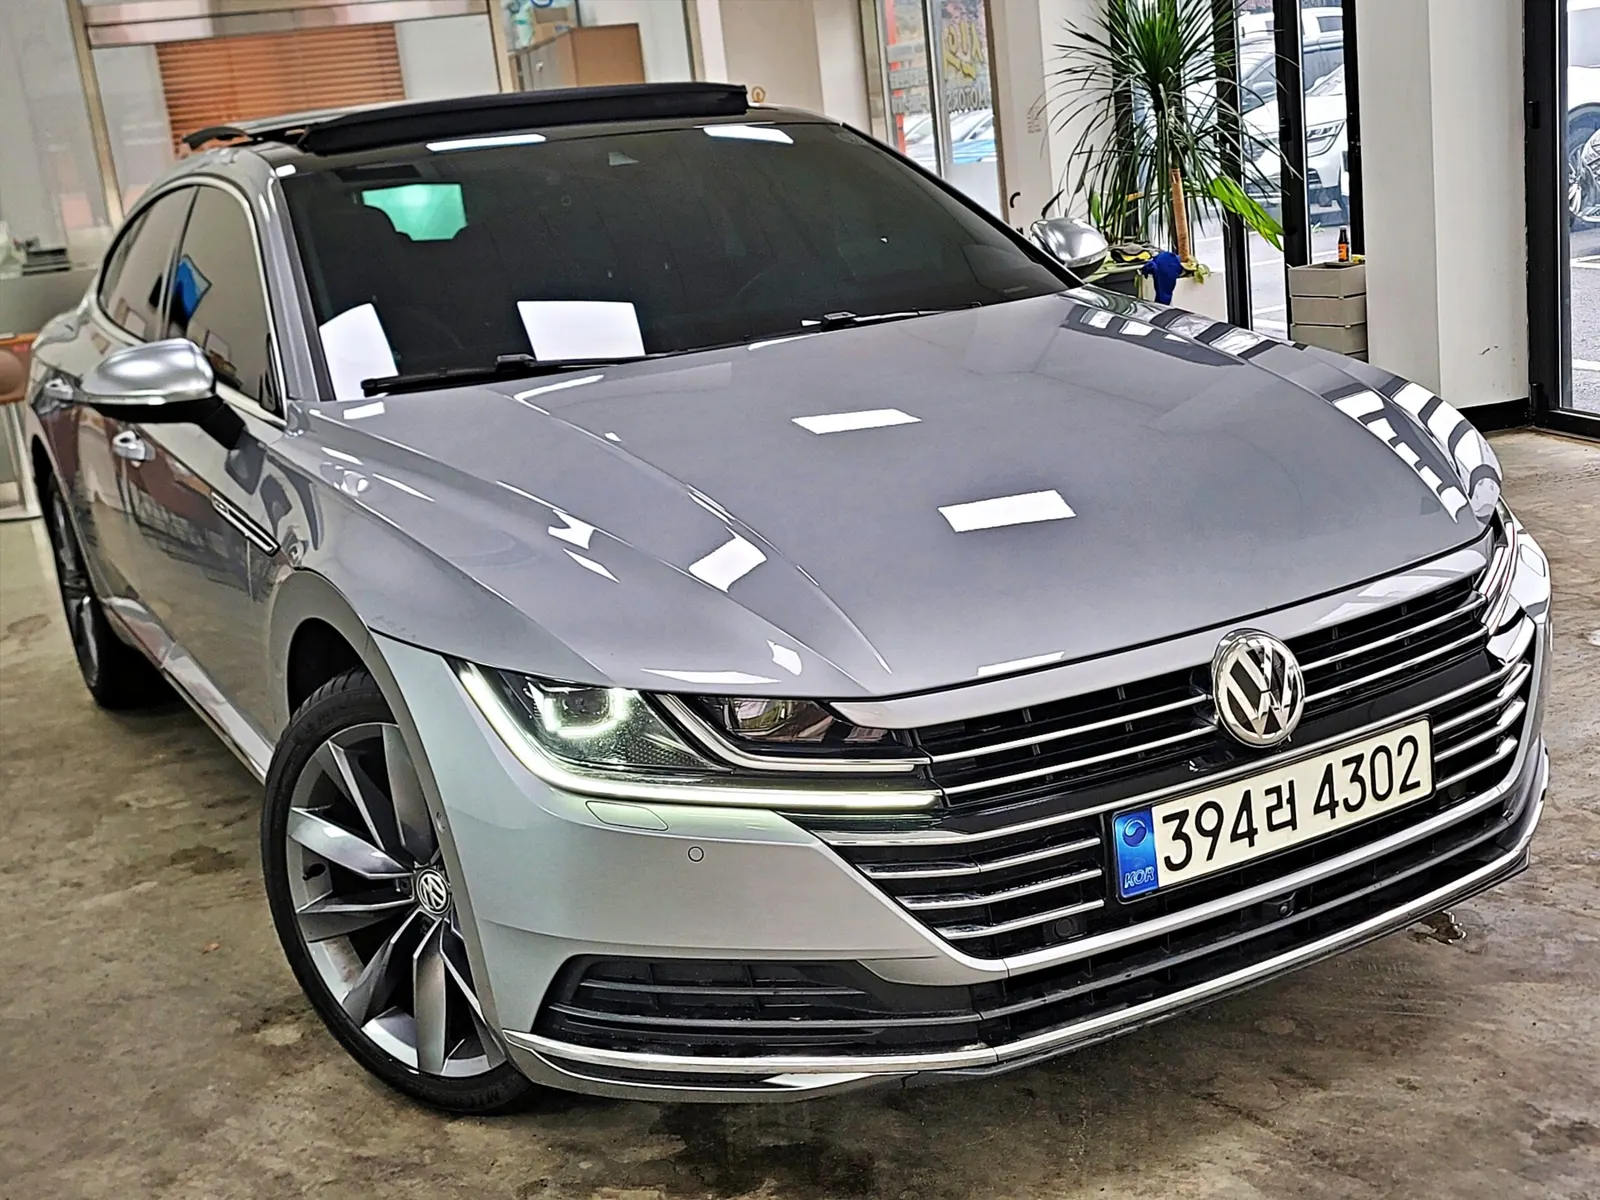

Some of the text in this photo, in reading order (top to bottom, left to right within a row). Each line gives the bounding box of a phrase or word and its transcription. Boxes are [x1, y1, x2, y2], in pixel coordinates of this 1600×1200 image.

[1161, 735, 1421, 872] 394러 4302
[1124, 866, 1155, 889] KOR
